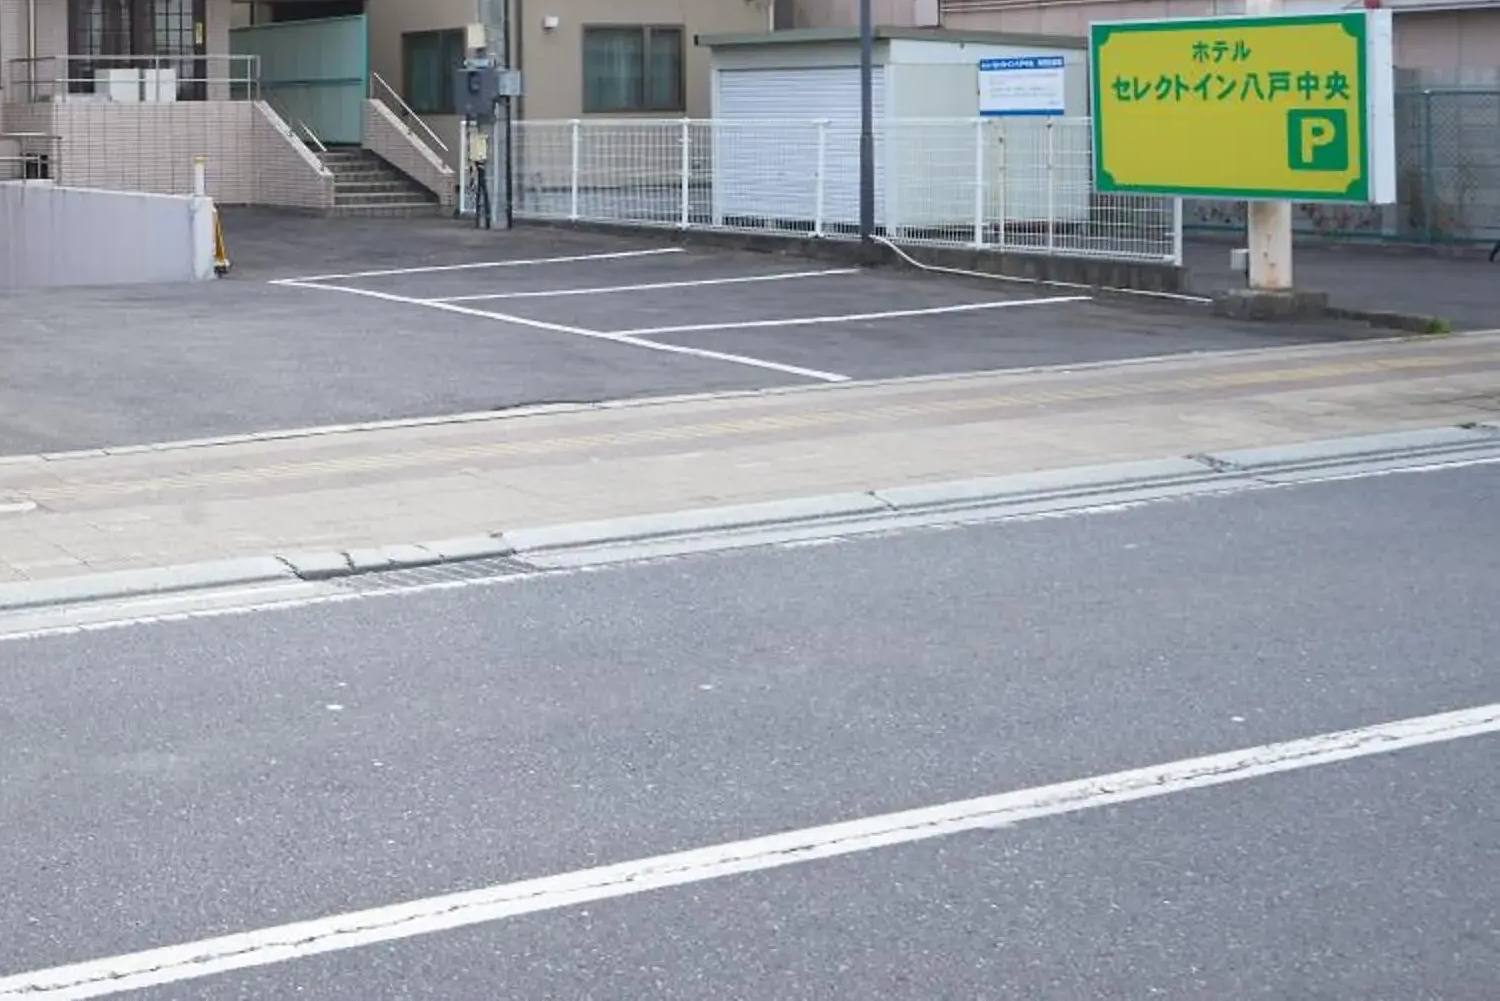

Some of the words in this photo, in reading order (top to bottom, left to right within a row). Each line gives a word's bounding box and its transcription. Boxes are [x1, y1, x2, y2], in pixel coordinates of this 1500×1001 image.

[1192, 39, 1251, 64] ホテル
[1112, 71, 1350, 102] セレクトイン八戸中央
[1300, 118, 1337, 163] P
